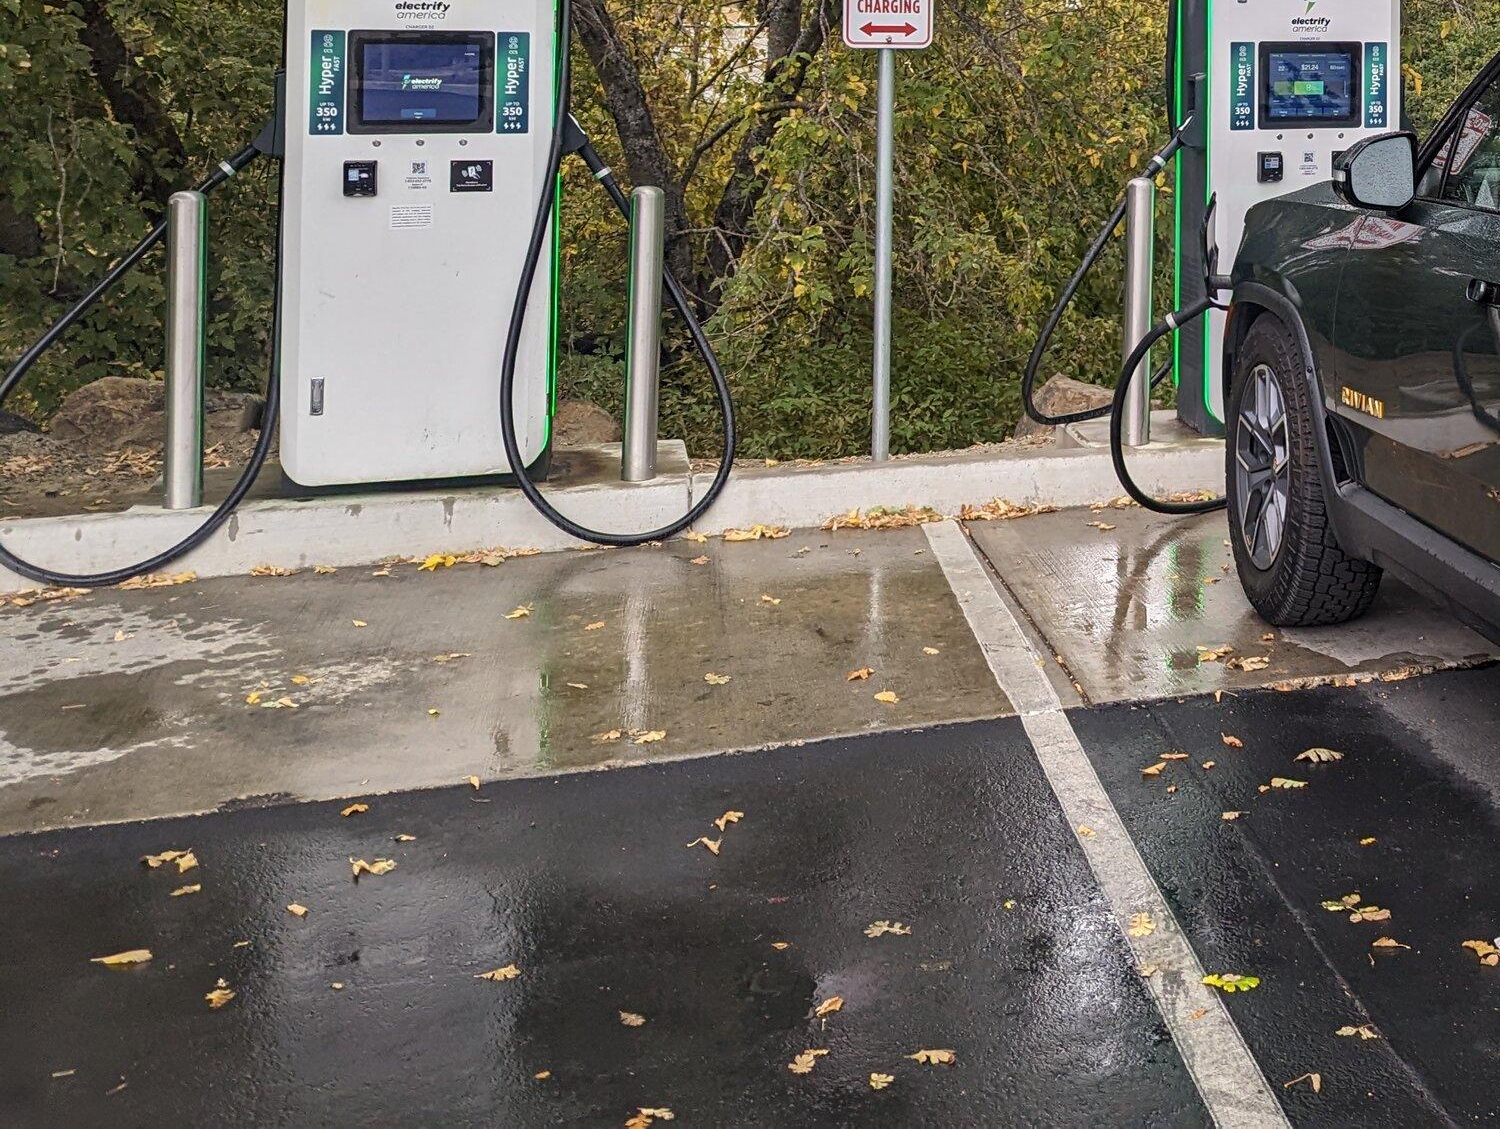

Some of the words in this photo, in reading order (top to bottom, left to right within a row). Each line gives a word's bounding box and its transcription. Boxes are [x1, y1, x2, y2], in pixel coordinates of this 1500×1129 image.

[395, 1, 451, 12] electrify
[858, 0, 920, 13] CHARGING
[396, 11, 446, 19] america
[1291, 17, 1330, 26] electrify
[319, 56, 334, 94] Hyper
[505, 57, 519, 94] Hyper
[1236, 64, 1247, 96] Hyper
[1370, 63, 1380, 95] Hyper
[316, 107, 337, 116] 350
[503, 107, 522, 116] 350
[1368, 105, 1383, 113] 350
[1341, 386, 1384, 418] RIVIAN
